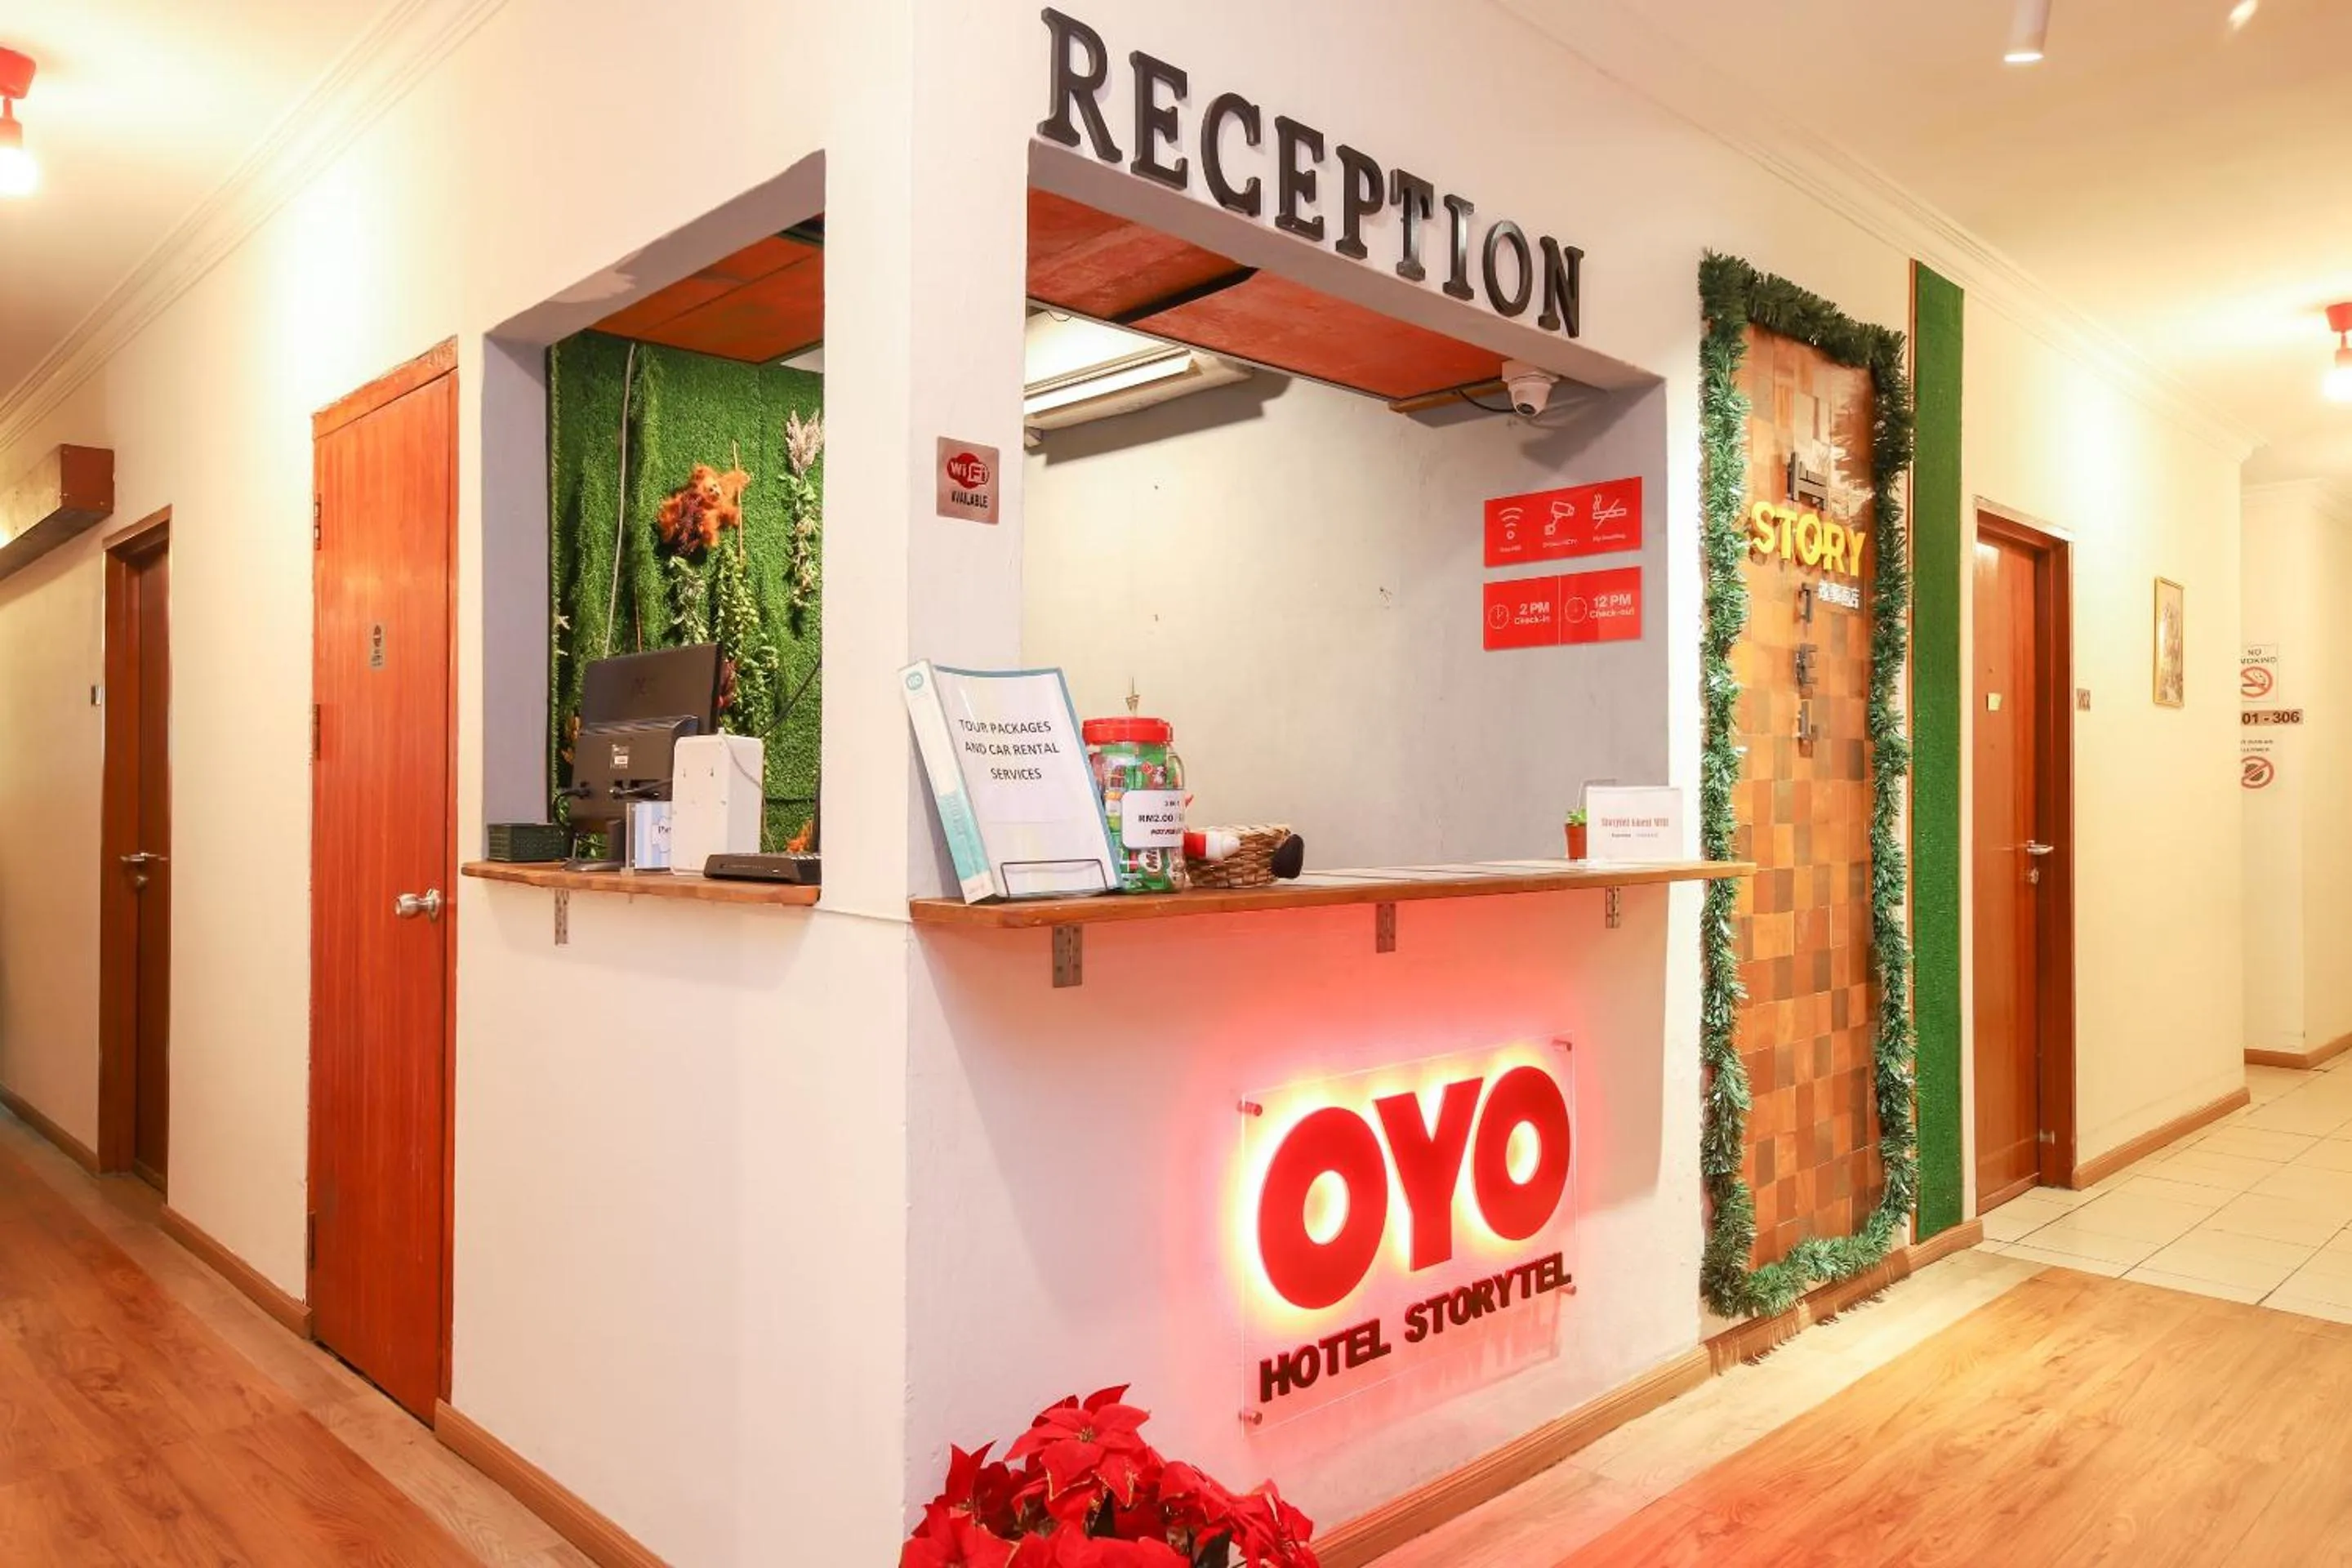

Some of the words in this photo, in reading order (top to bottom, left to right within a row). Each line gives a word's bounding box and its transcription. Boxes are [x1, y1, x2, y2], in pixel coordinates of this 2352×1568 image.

[1037, 7, 1584, 337] RECEPTION
[1751, 501, 1866, 577] STORY
[1519, 603, 1528, 615] 2
[1530, 601, 1550, 613] PM
[1592, 596, 1606, 608] 12
[1610, 594, 1632, 606] PM
[2272, 710, 2300, 724] 306
[959, 719, 989, 733] TOUR
[991, 721, 1052, 734] PACKAGES
[965, 741, 987, 755] AND
[989, 744, 1011, 755] CAR
[1012, 742, 1061, 755] RENTAL
[991, 768, 1042, 781] SERVICES
[1257, 1065, 1571, 1311] OYO
[1259, 1317, 1392, 1404] HOTEL
[1404, 1251, 1572, 1344] STORYTEL
